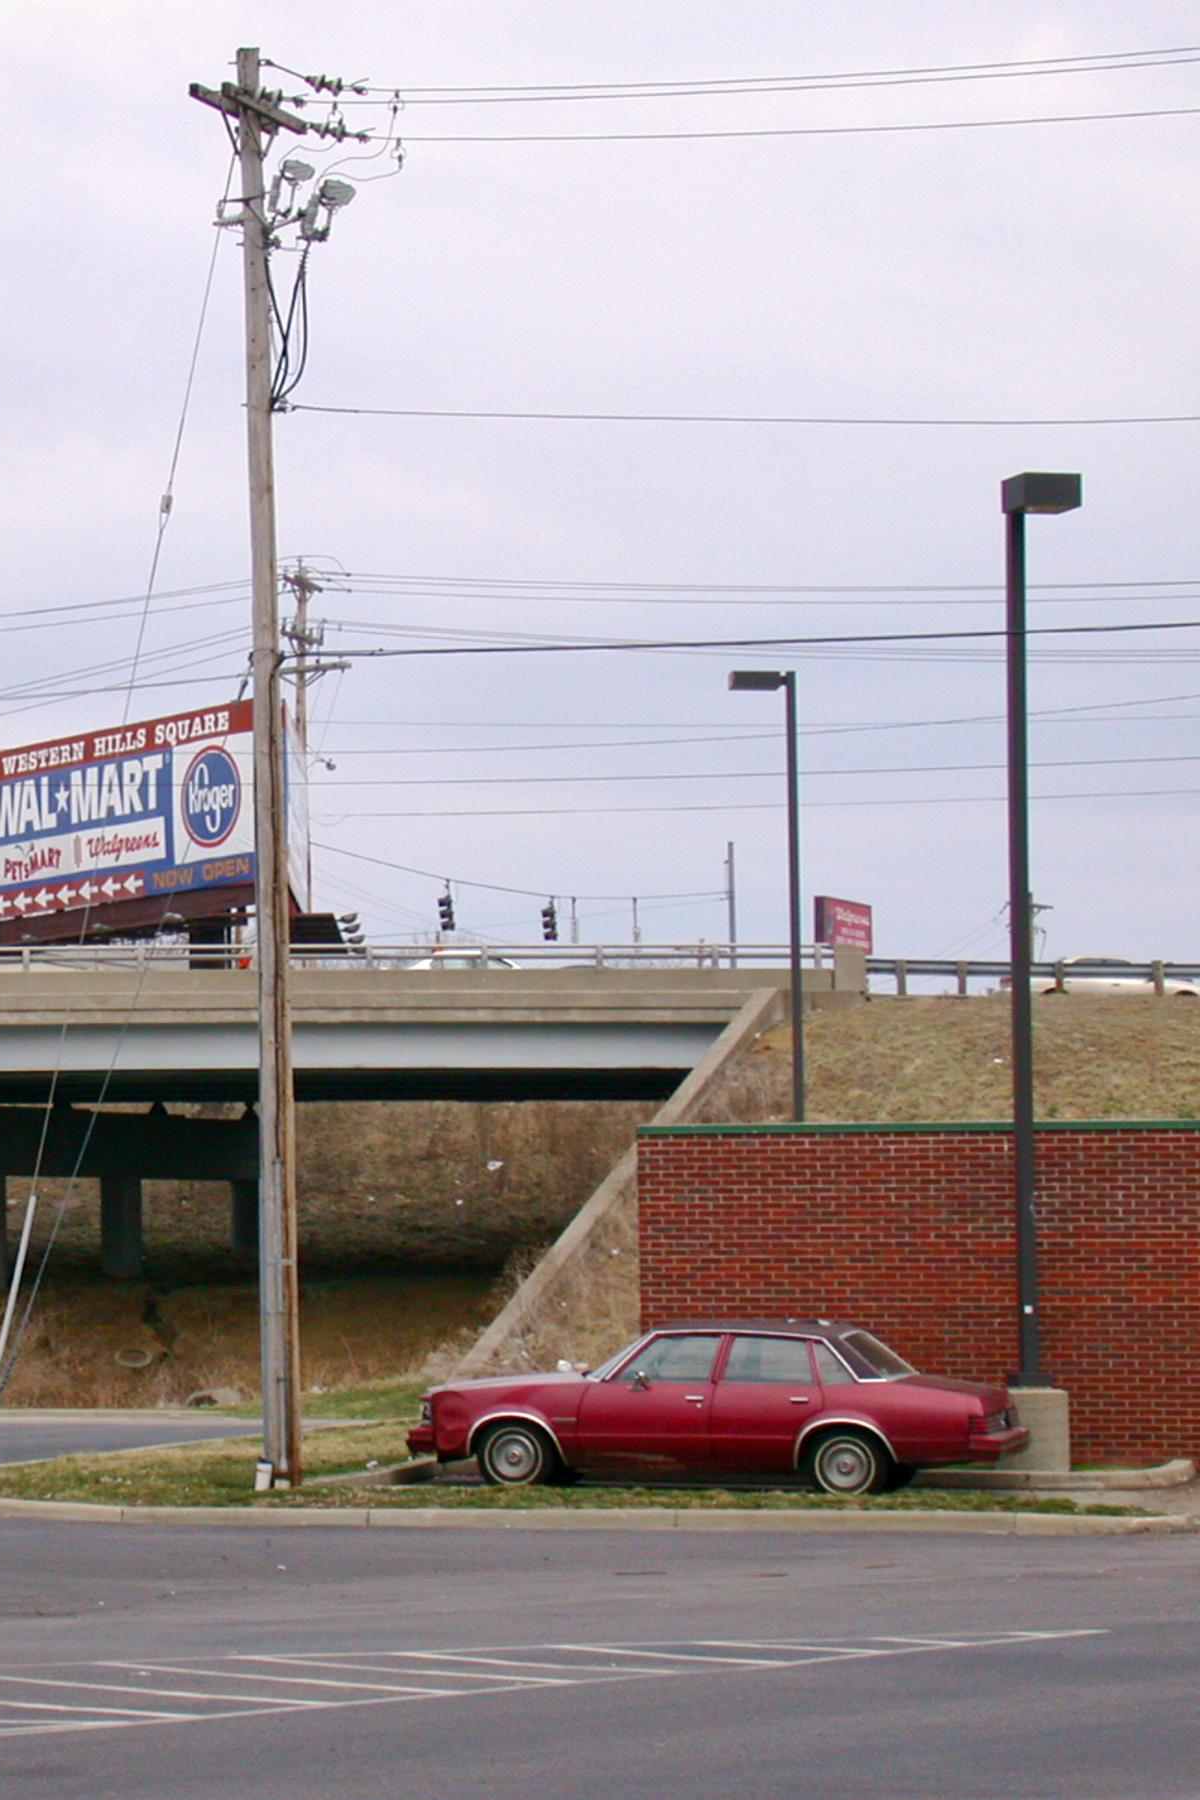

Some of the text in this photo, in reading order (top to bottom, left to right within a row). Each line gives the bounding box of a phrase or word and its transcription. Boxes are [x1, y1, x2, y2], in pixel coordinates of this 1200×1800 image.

[1, 711, 230, 776] WESTERN HILLS SQUARE
[188, 763, 235, 833] Kroger
[87, 831, 160, 863] Walgreens
[153, 857, 250, 888] NOW OPEN
